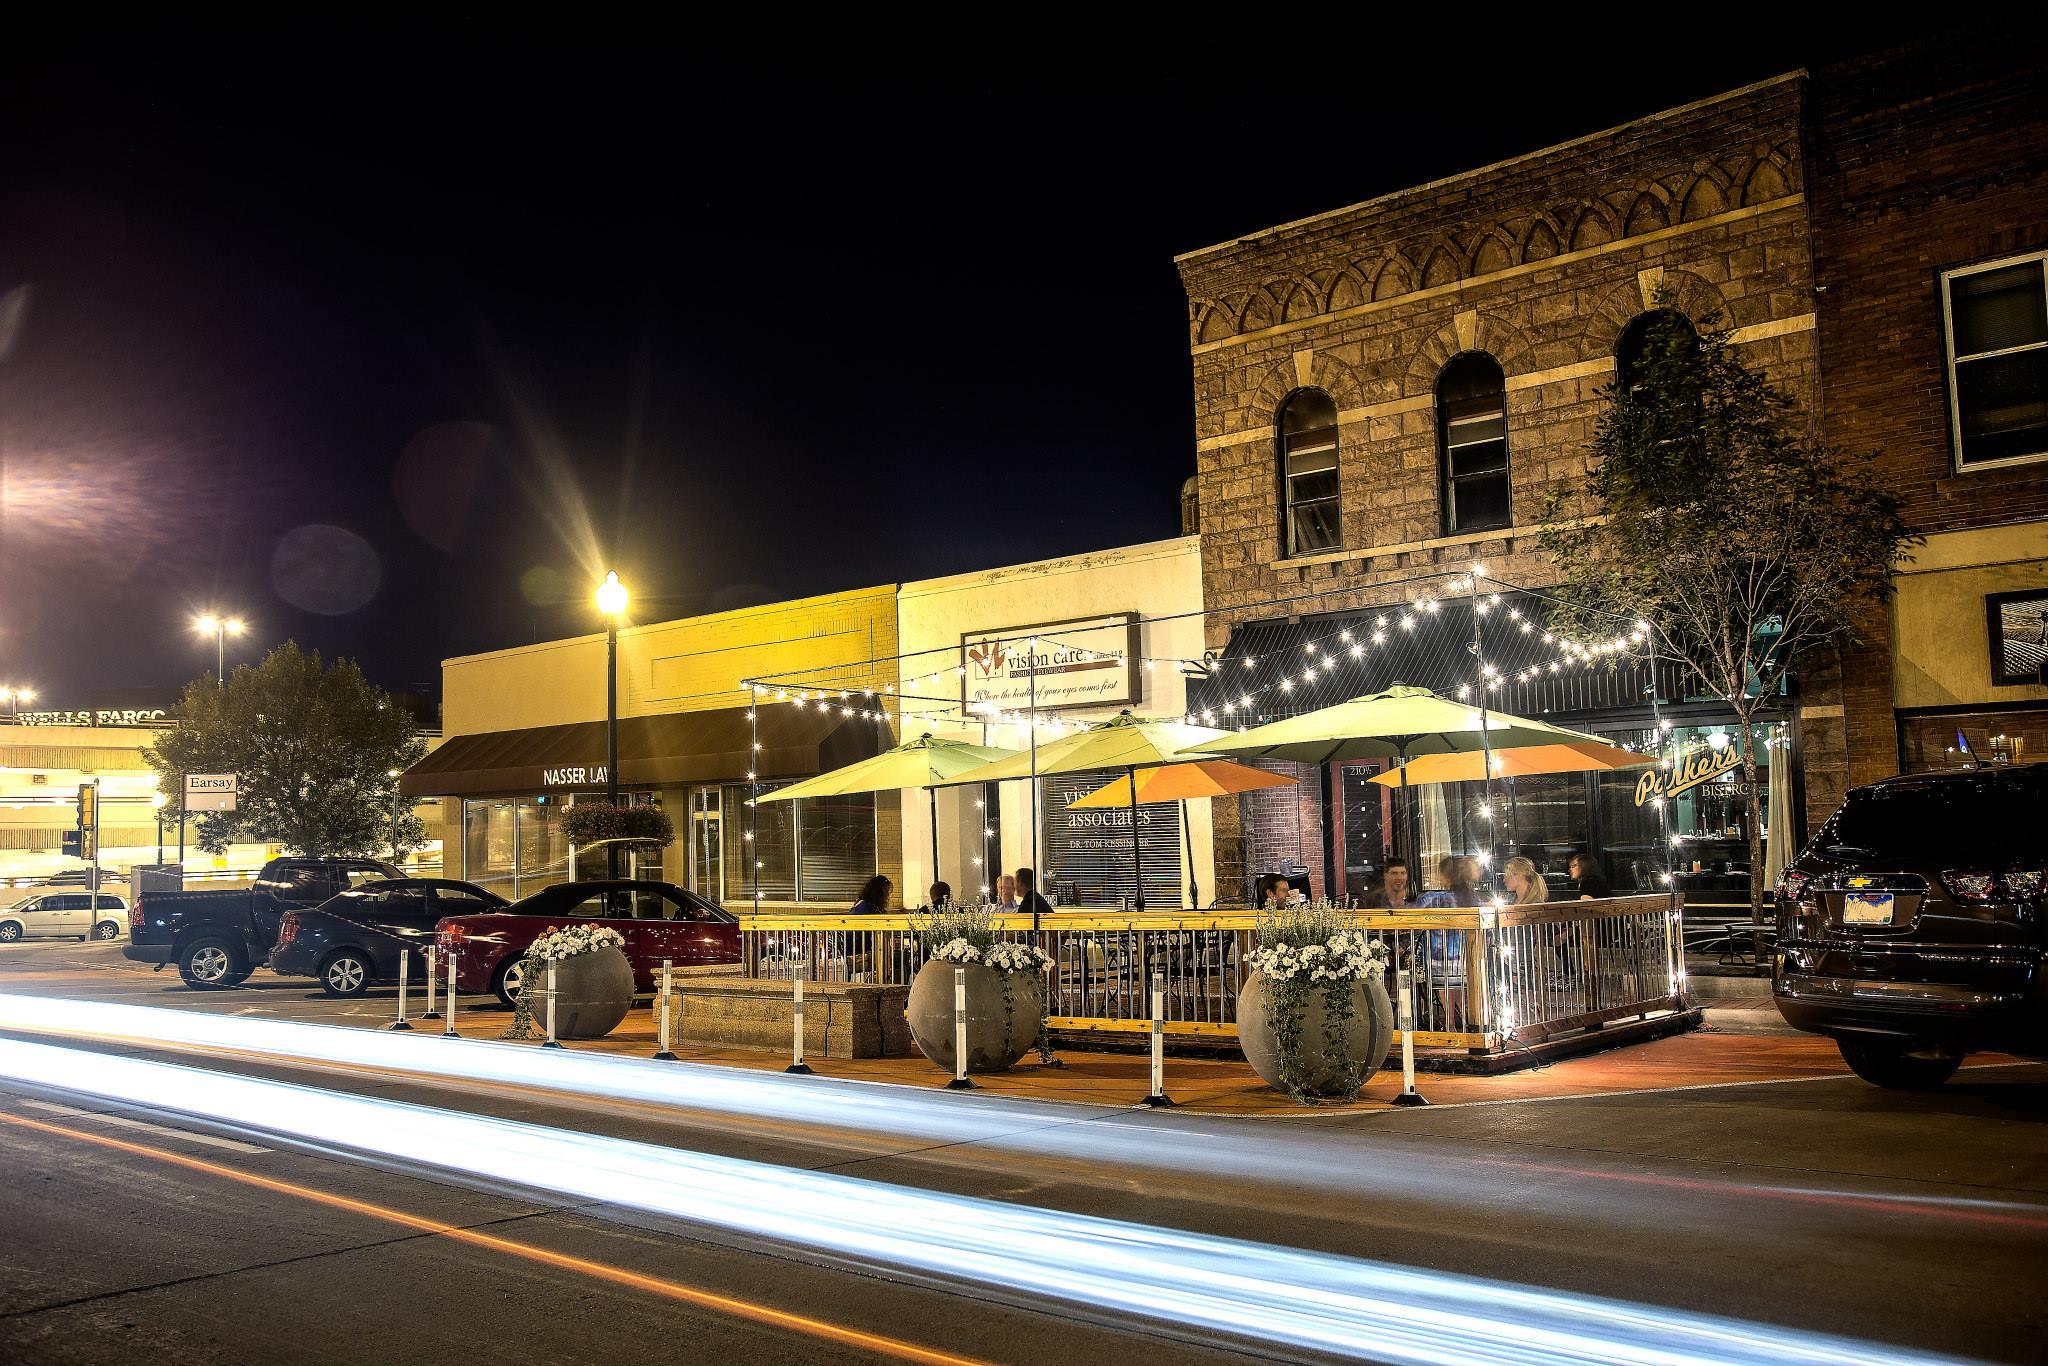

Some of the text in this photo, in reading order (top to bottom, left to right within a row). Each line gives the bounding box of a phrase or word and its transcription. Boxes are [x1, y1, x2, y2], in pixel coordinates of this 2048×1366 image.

[1008, 651, 1049, 669] vision
[1054, 649, 1083, 664] care
[1044, 688, 1062, 700] your
[1063, 687, 1077, 697] eyes
[1079, 684, 1100, 693] comes
[1100, 679, 1118, 694] first
[17, 712, 91, 726] WELLS
[190, 777, 233, 789] Earsay
[543, 767, 586, 785] NASSER
[1068, 807, 1151, 827] associates
[1084, 840, 1102, 849] TOM
